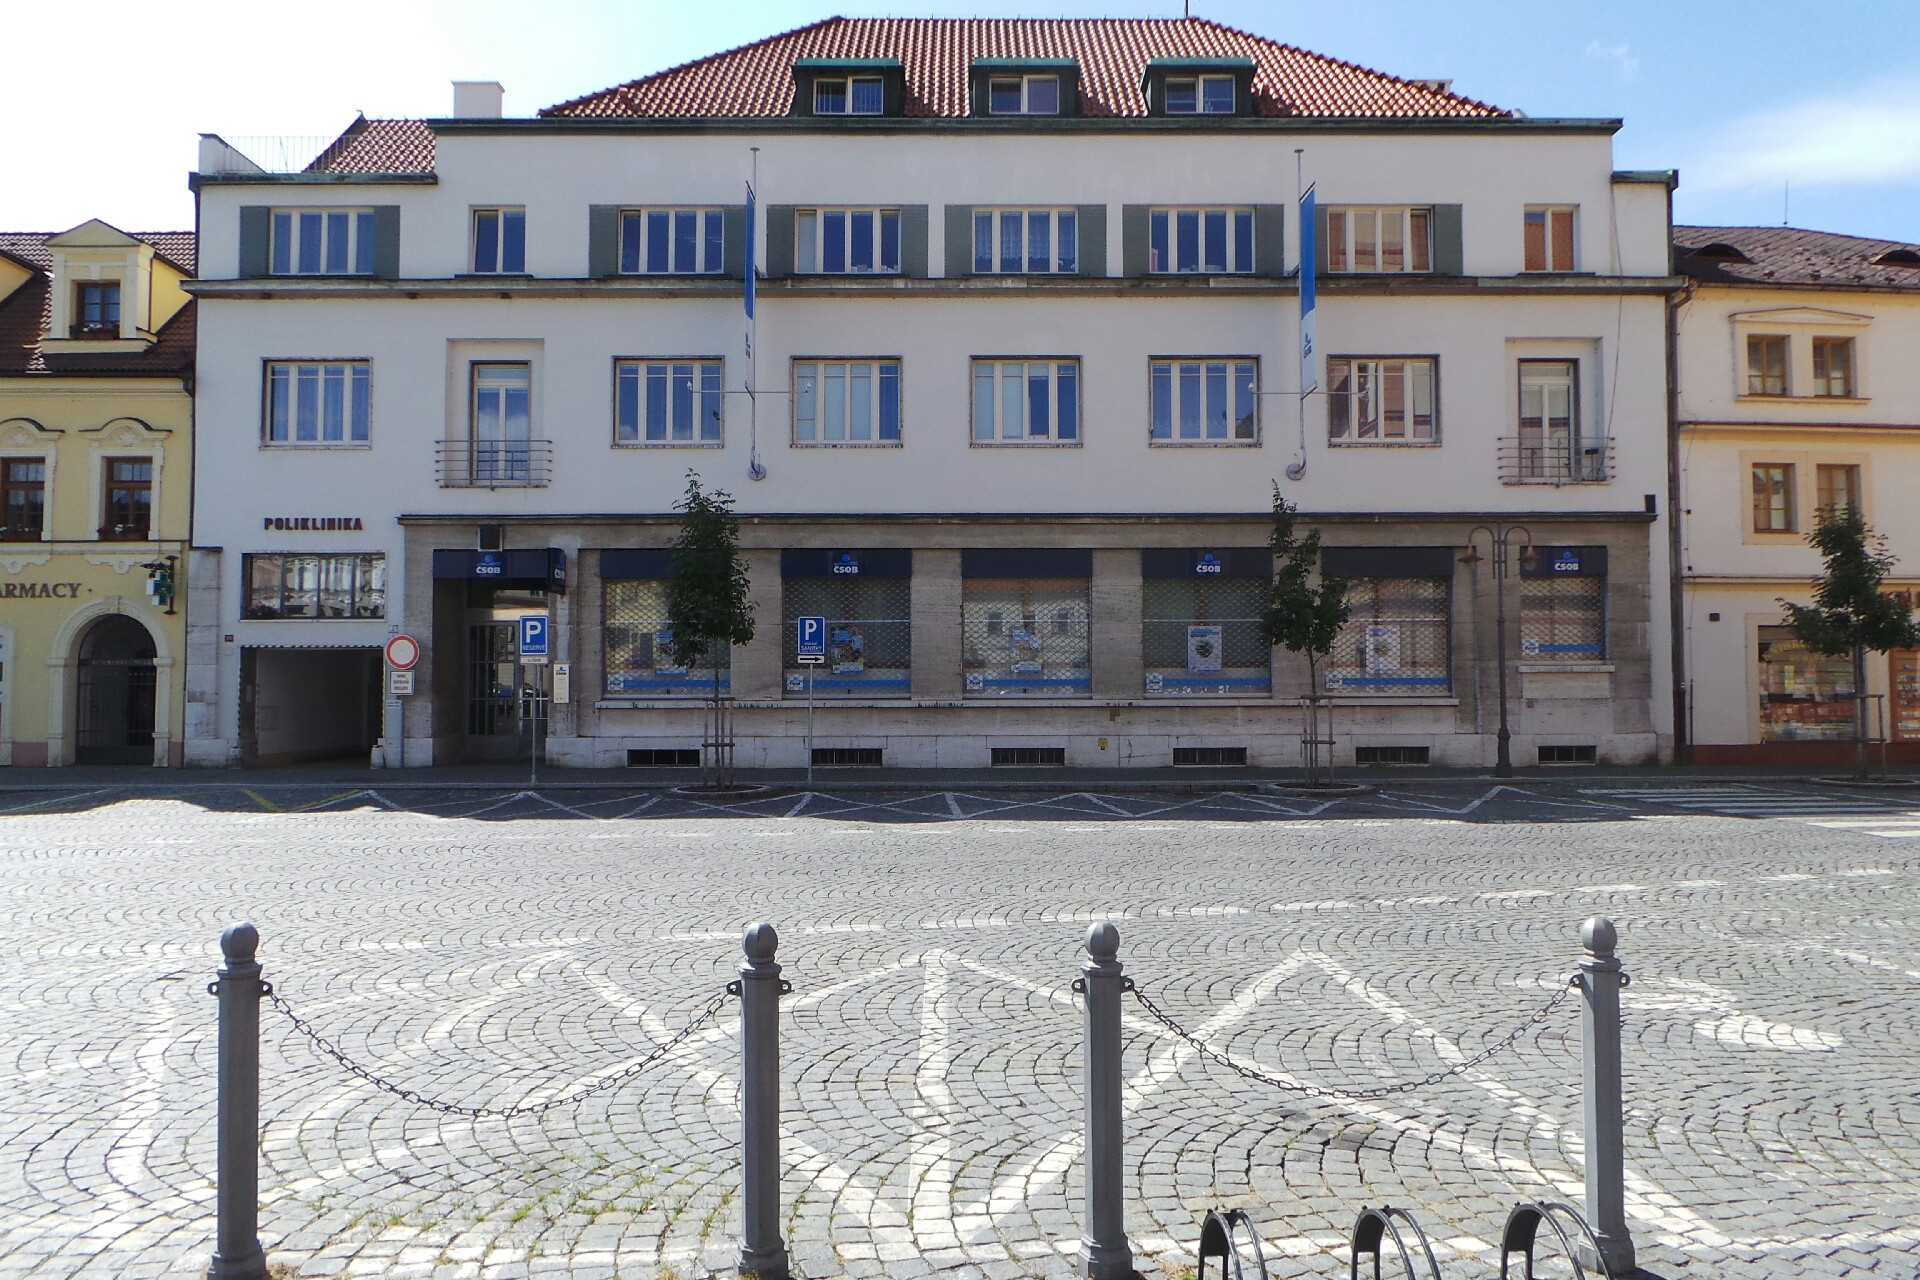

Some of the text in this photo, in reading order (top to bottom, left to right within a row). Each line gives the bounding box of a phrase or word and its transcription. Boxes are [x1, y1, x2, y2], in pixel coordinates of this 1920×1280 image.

[264, 518, 362, 530] POLIKLINIKA
[526, 621, 542, 643] P
[805, 620, 817, 640] P
